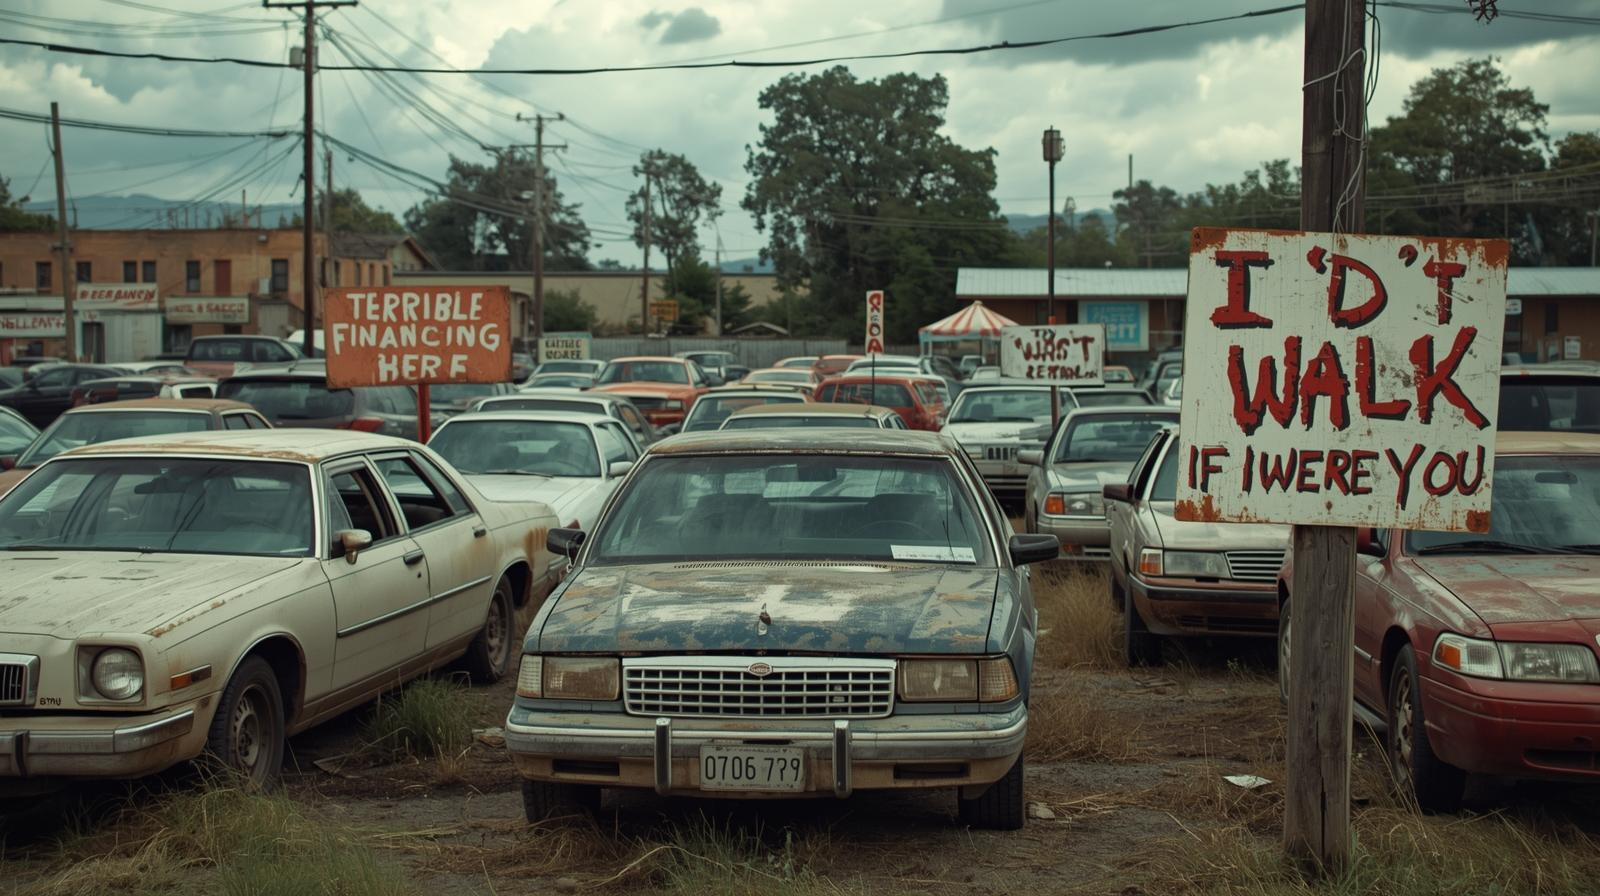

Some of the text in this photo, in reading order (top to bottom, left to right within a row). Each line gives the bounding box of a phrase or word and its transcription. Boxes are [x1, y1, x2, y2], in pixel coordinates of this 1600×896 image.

[346, 291, 484, 323] TERRIBLE
[332, 323, 500, 356] FINANCING
[1227, 325, 1491, 437] WALK
[1188, 443, 1486, 511] IF I WERE YOU
[705, 755, 756, 780] 0706
